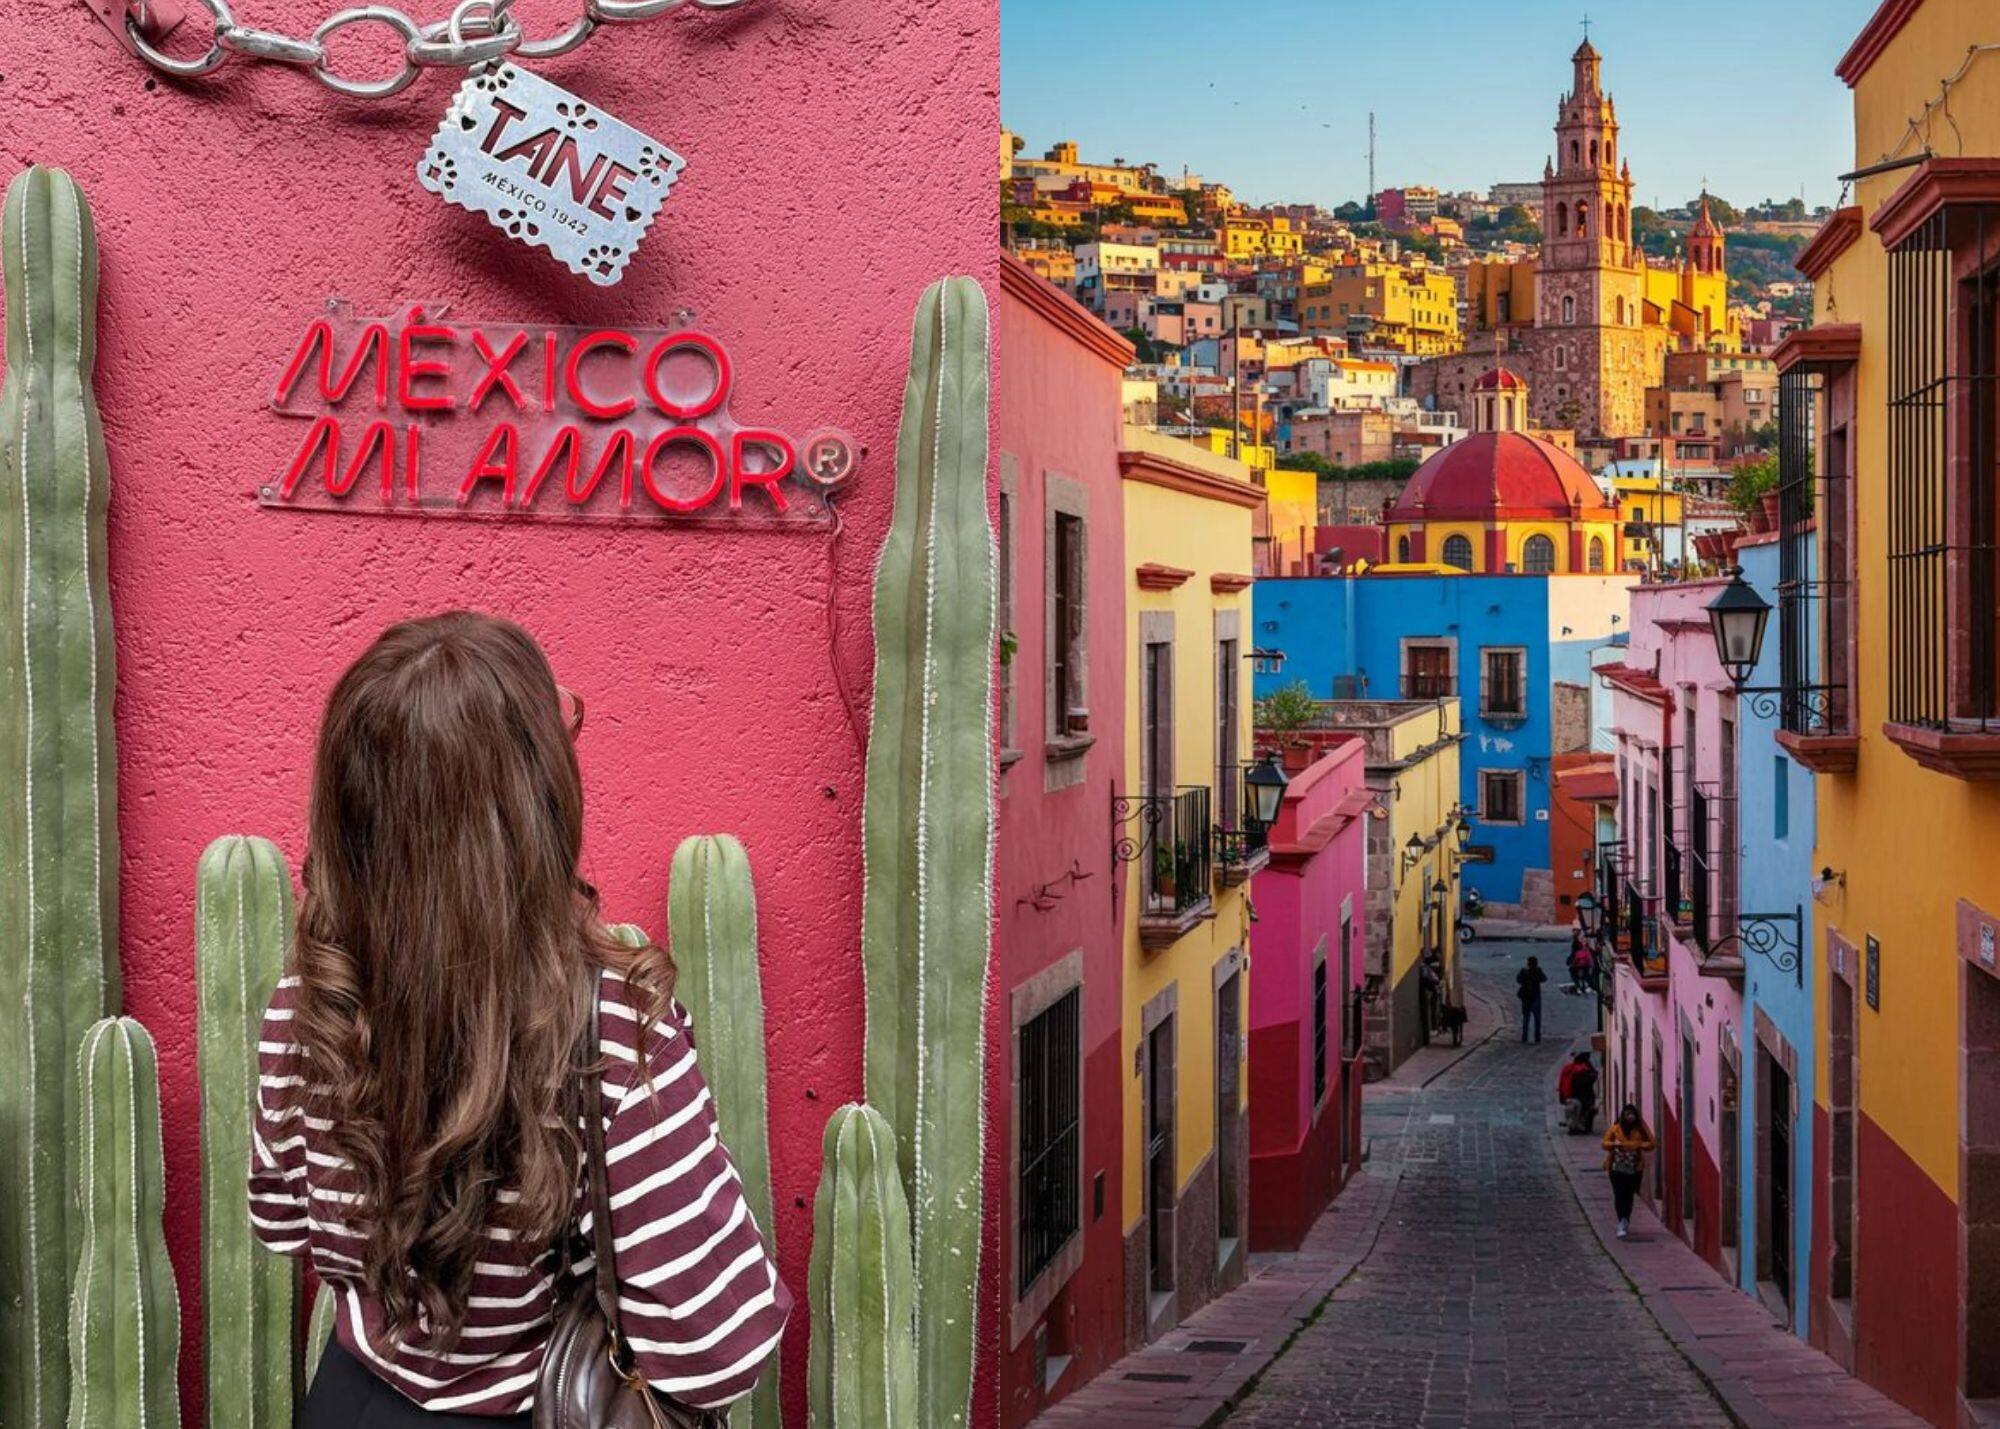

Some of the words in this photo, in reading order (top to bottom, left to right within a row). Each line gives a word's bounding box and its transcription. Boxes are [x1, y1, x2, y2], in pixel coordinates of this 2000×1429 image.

[480, 96, 638, 222] TANE
[482, 171, 547, 212] MÉXICO
[551, 207, 588, 236] 1942
[273, 304, 731, 419] MÉXICO
[279, 417, 420, 502] MI
